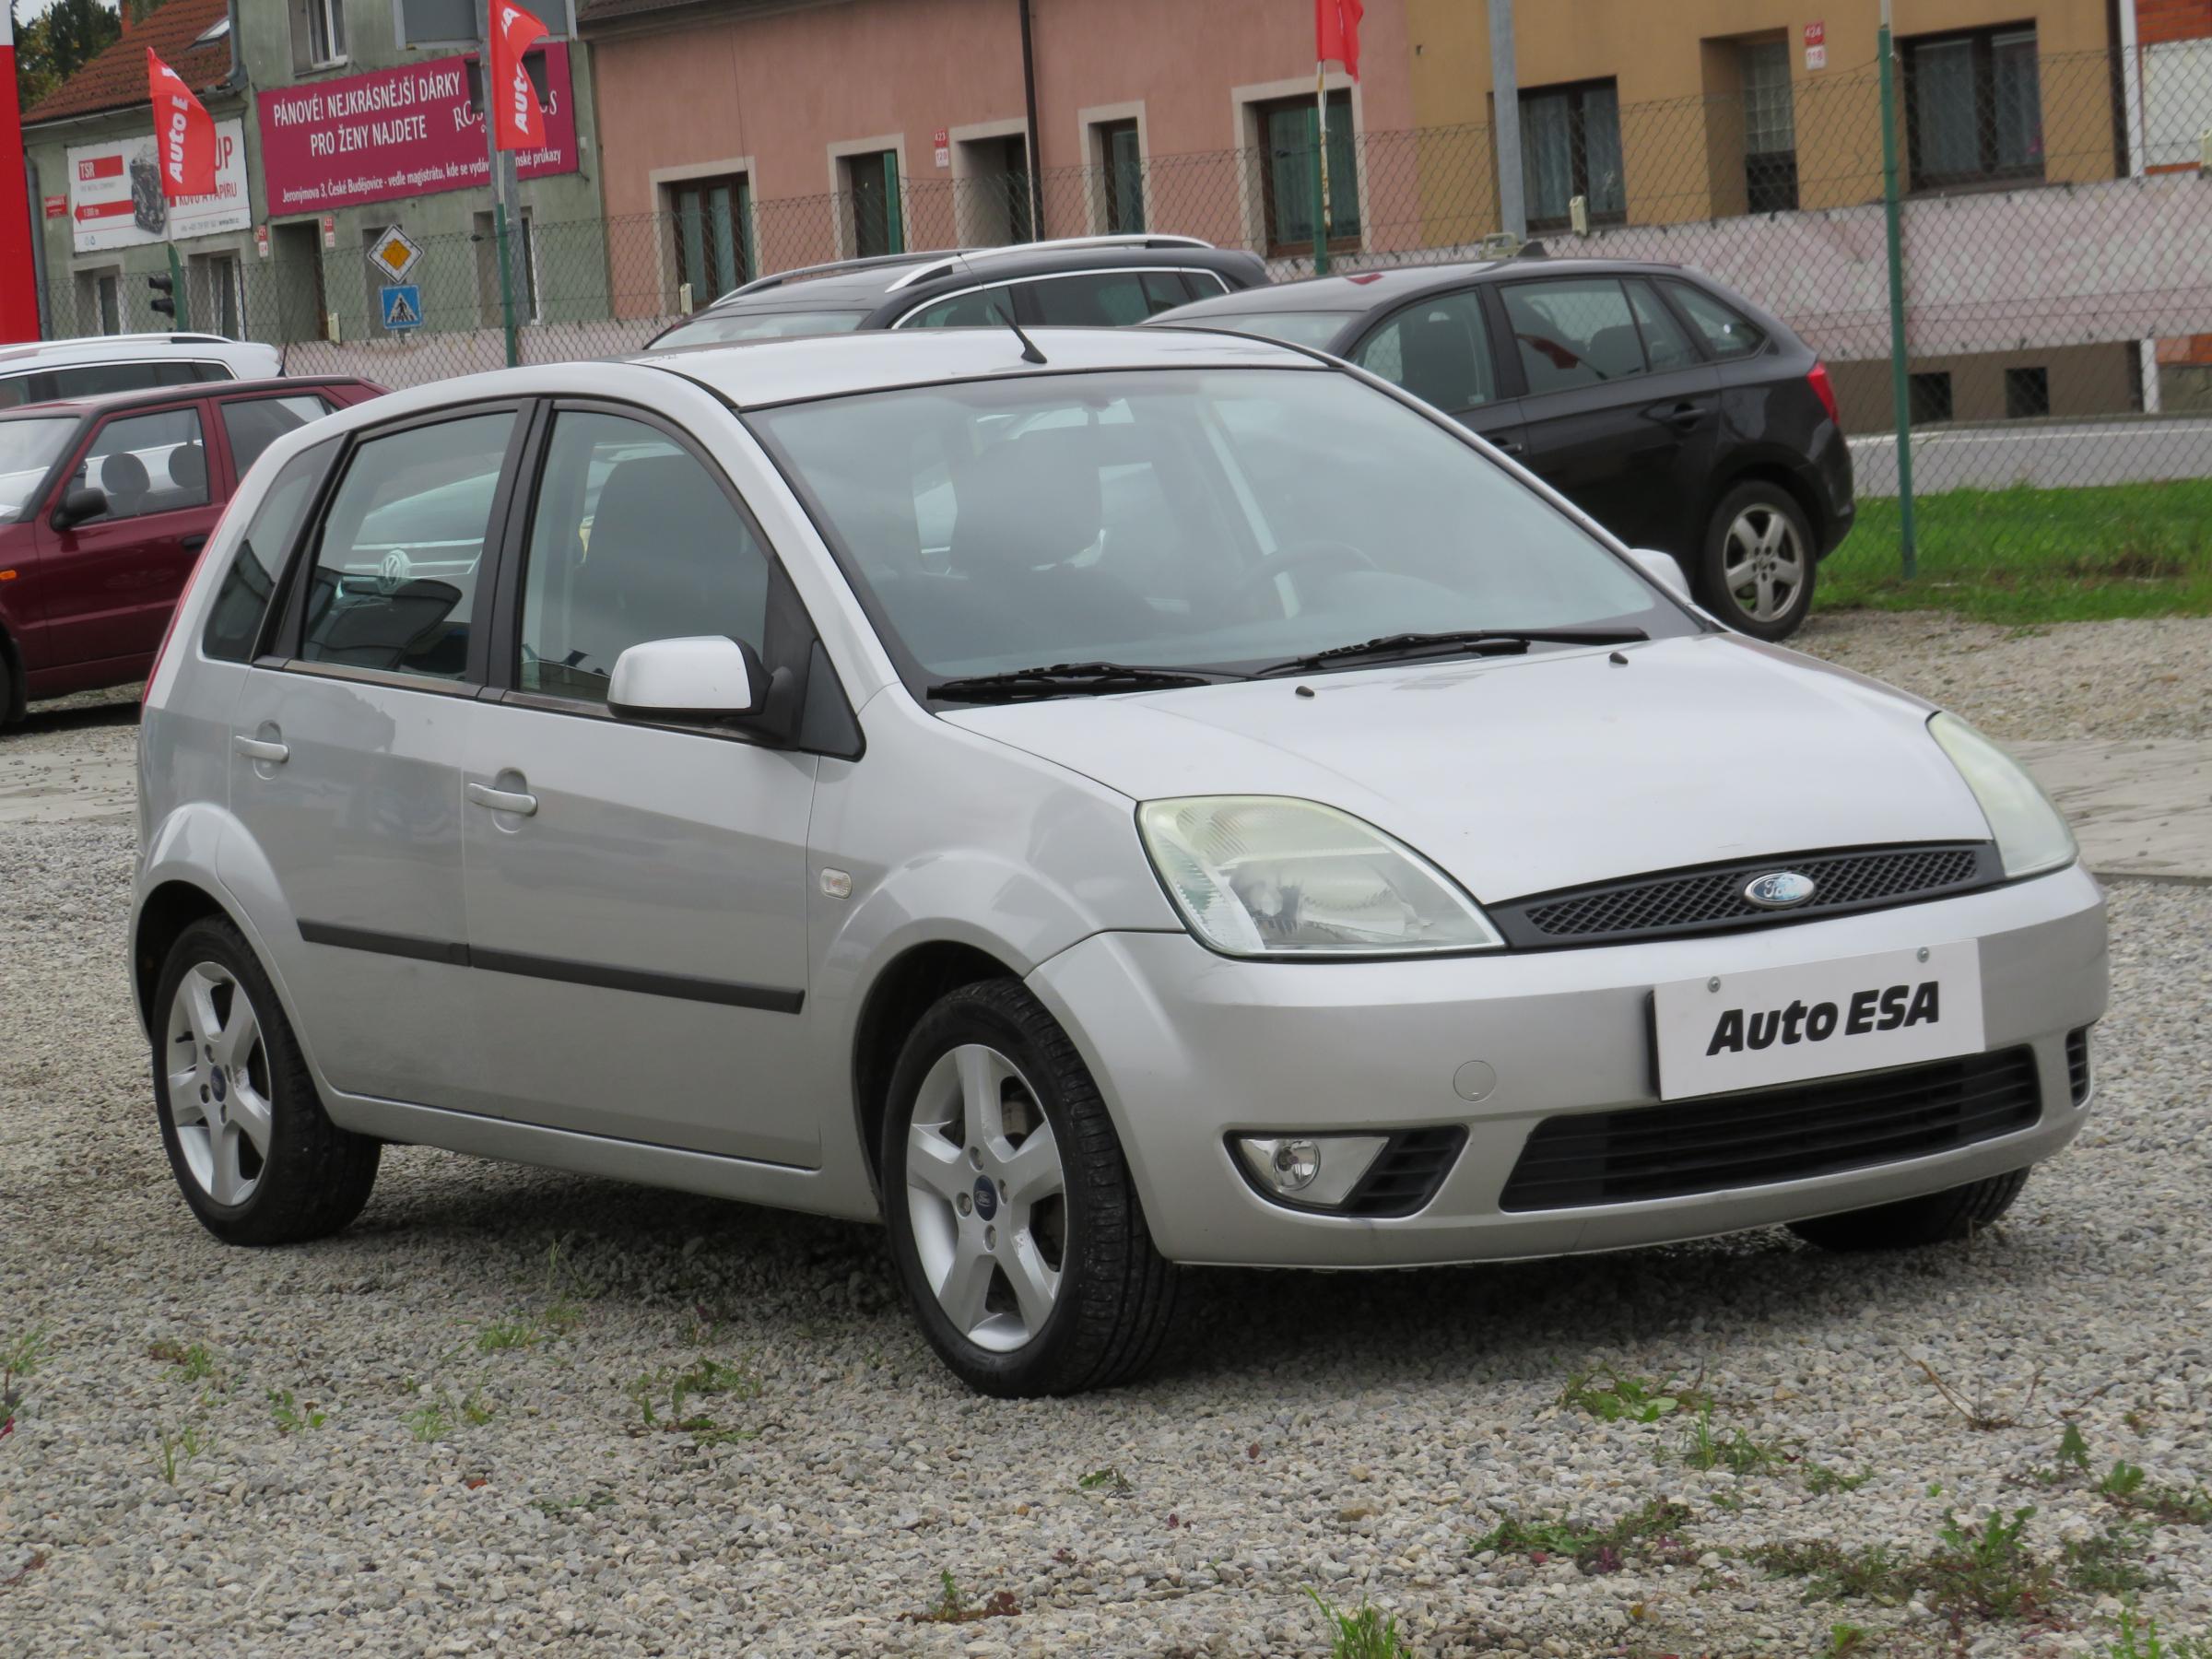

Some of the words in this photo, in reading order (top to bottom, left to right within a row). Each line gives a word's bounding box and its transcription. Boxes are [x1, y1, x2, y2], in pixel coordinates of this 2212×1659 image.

[273, 94, 324, 126] PÁNOVÉ!
[327, 76, 415, 118] NEJKRÁSNĚJŠÍ
[418, 70, 461, 102] DÁRKY
[512, 61, 529, 135] Aut
[169, 112, 187, 184] Auto
[310, 131, 335, 157] PRO
[337, 124, 369, 153] ŽENY
[371, 114, 428, 147] NAJDETE
[79, 161, 95, 179] TSR
[282, 186, 320, 204] Jeronýmova
[320, 182, 328, 199] 3,
[327, 178, 347, 196] České
[347, 175, 383, 195] Budějovice
[387, 170, 406, 187] vedle
[406, 164, 445, 187] magistrátu,
[445, 161, 459, 179] kde
[460, 163, 468, 176] se
[1705, 999, 1839, 1057] Auto
[1844, 980, 1940, 1036] ESA
